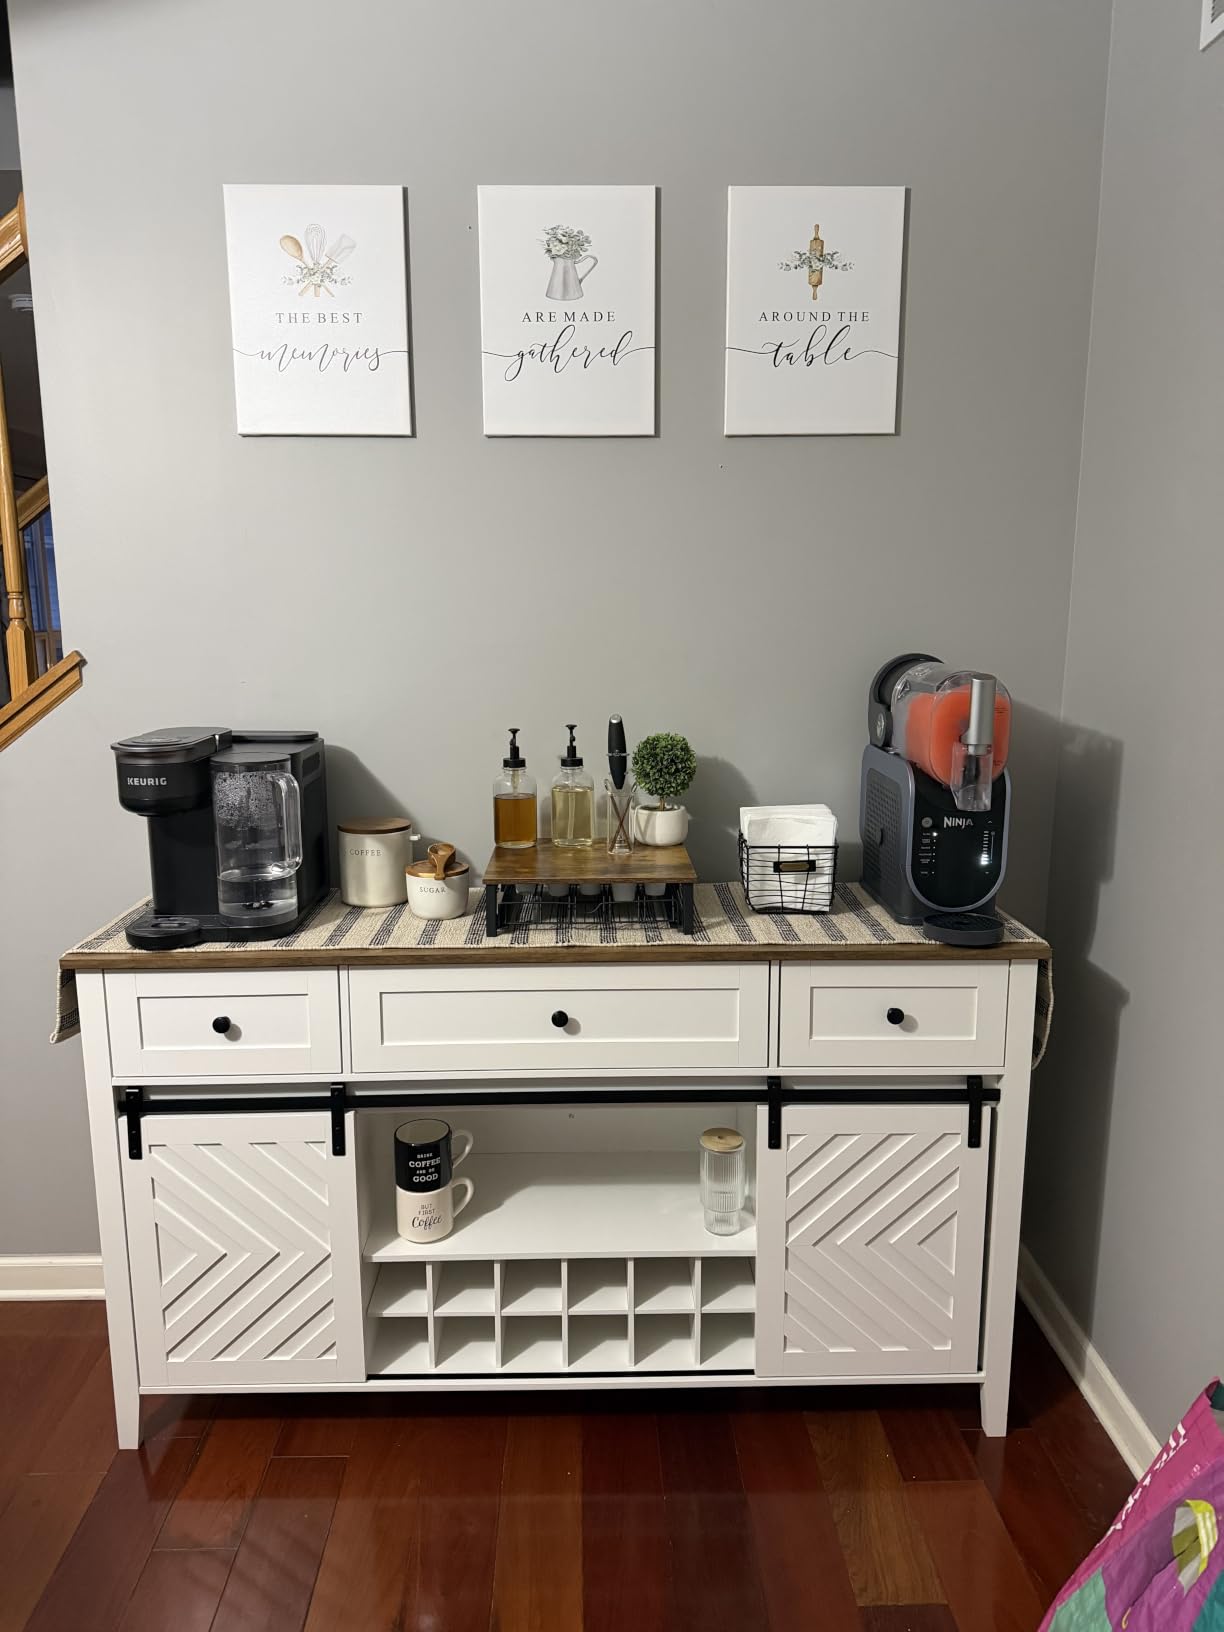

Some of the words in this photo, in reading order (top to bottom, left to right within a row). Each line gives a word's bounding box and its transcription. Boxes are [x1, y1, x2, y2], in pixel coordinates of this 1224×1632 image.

[275, 312, 311, 324] THE
[317, 312, 363, 324] BEST
[521, 311, 558, 323] ARE
[563, 311, 617, 323] MADE
[758, 311, 832, 323] AROUND
[837, 311, 871, 323] THE
[745, 324, 875, 368] table
[243, 343, 395, 373] memories
[494, 324, 643, 382] gathered
[127, 776, 169, 787] KEURIG
[943, 816, 974, 829] NINJA
[349, 848, 383, 857] COFFEE
[419, 886, 447, 894] SUGAR
[408, 1156, 441, 1168] COFFEE
[412, 1173, 439, 1183] GOOD
[411, 1215, 442, 1231] Coffee
